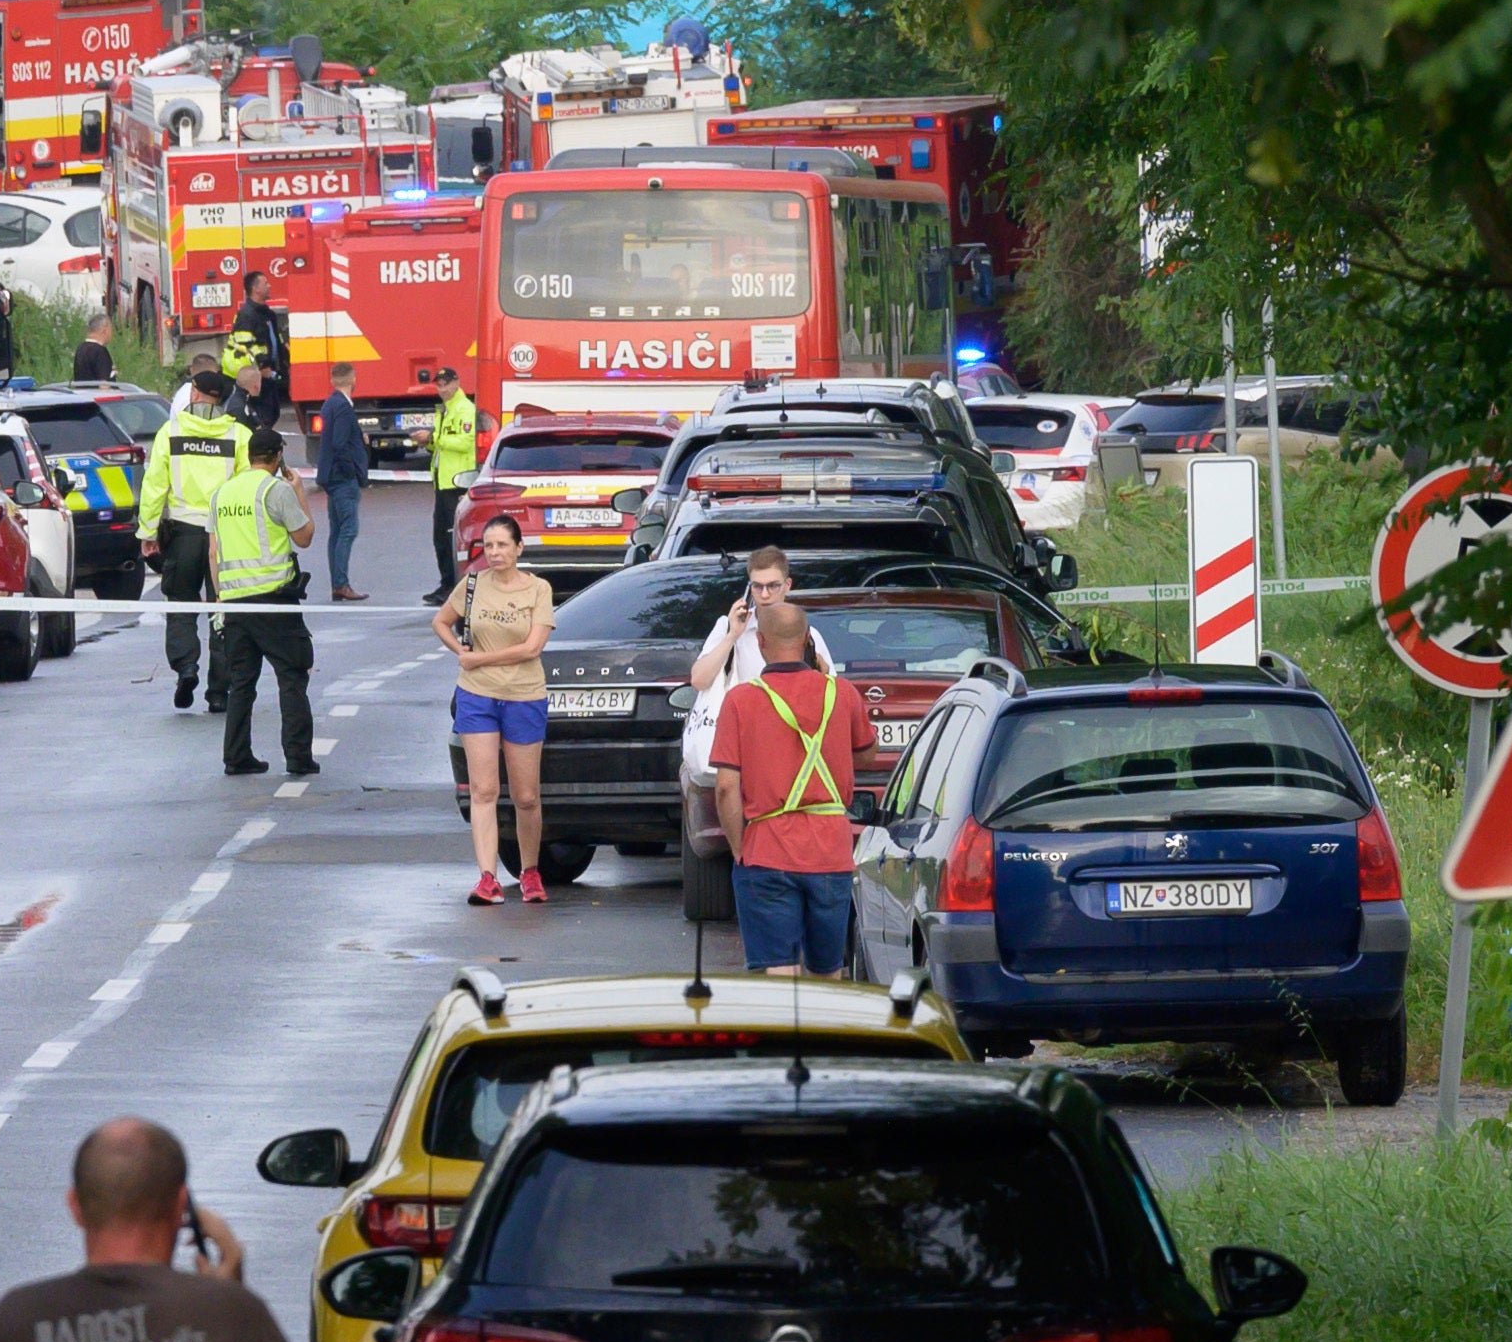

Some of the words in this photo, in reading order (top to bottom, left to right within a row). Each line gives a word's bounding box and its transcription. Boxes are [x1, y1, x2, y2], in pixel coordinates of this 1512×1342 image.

[102, 23, 130, 50] 150
[12, 61, 33, 82] SOS
[34, 60, 52, 80] 112
[64, 52, 150, 85] HASIČ
[250, 170, 350, 197] HASIČI
[200, 207, 225, 216] PHO
[222, 259, 237, 270] 100
[379, 253, 461, 284] HASIČI
[539, 274, 573, 299] 150
[731, 272, 764, 298] SOS
[769, 272, 796, 298] 112
[512, 350, 534, 363] 100
[578, 331, 732, 370] HASIČI
[182, 441, 222, 454] POLÍCIA
[217, 503, 253, 518] POLÍCIA
[552, 667, 635, 676] KODA
[575, 692, 632, 709] 416BY
[1003, 851, 1070, 863] PEUGEOT
[1308, 842, 1341, 855] 307
[1123, 885, 1155, 909] NZ
[1167, 882, 1247, 907] 380DY
